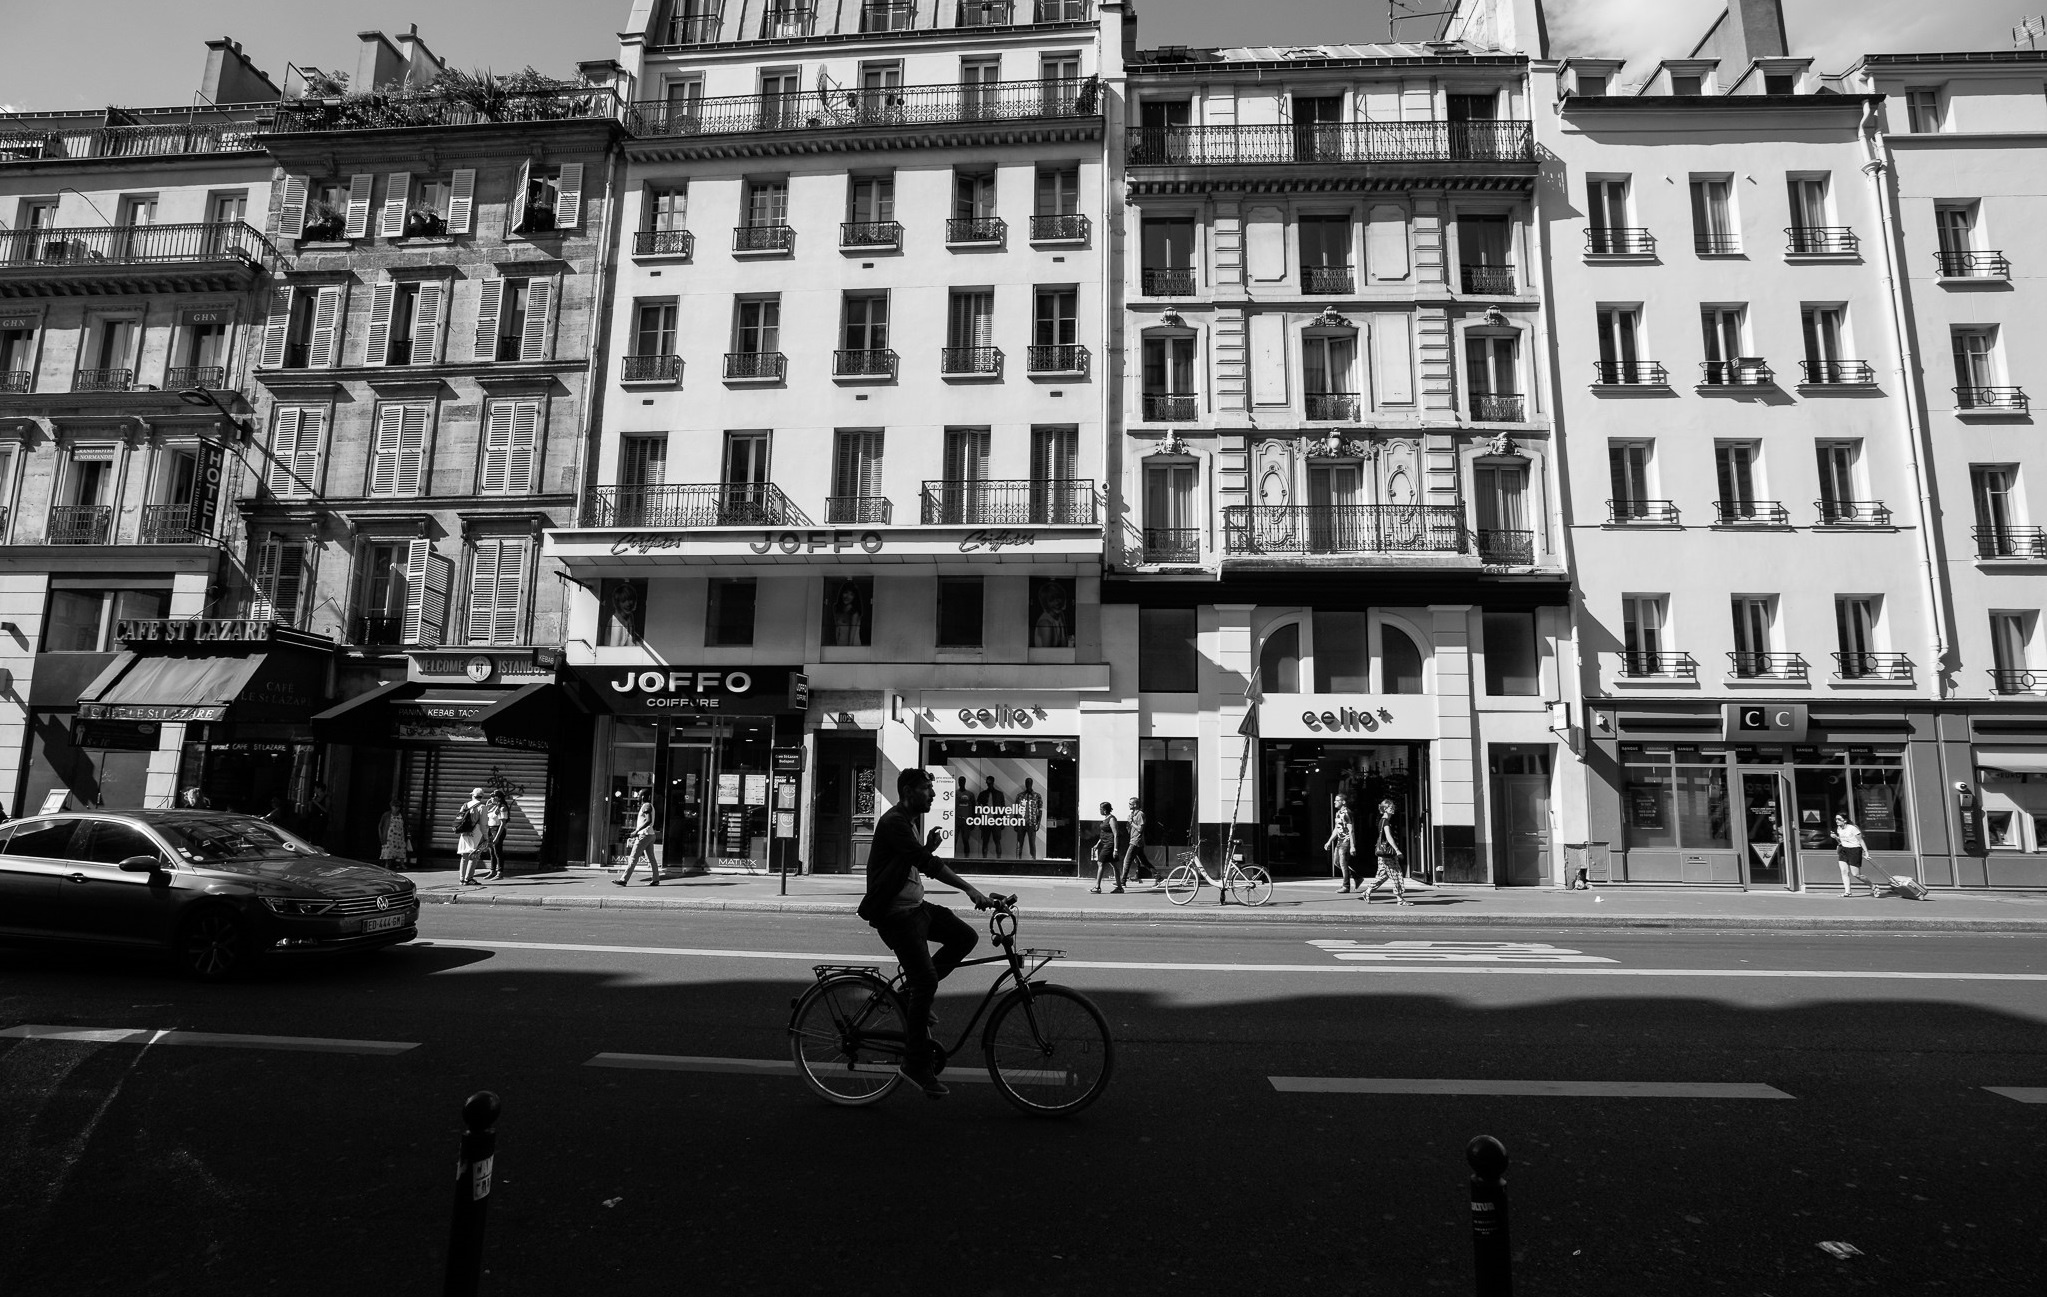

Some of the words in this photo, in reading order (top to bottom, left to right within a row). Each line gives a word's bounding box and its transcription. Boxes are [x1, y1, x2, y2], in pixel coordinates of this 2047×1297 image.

[193, 313, 218, 322] GHN
[2, 319, 26, 327] GHN
[201, 450, 222, 533] HOTEL
[750, 530, 882, 554] JOFFO
[114, 621, 158, 641] CAFE
[165, 621, 188, 641] ST
[194, 621, 271, 641] LAZARE
[539, 655, 555, 665] KEBAB
[416, 659, 465, 673] WELCOME
[611, 671, 752, 693] JOFFO
[646, 698, 720, 708] COIFFURE
[495, 735, 514, 746] KEBAB
[942, 791, 954, 801] 3€
[975, 804, 1026, 814] nouvelle
[942, 811, 954, 820] 5€
[965, 815, 1026, 826] collection
